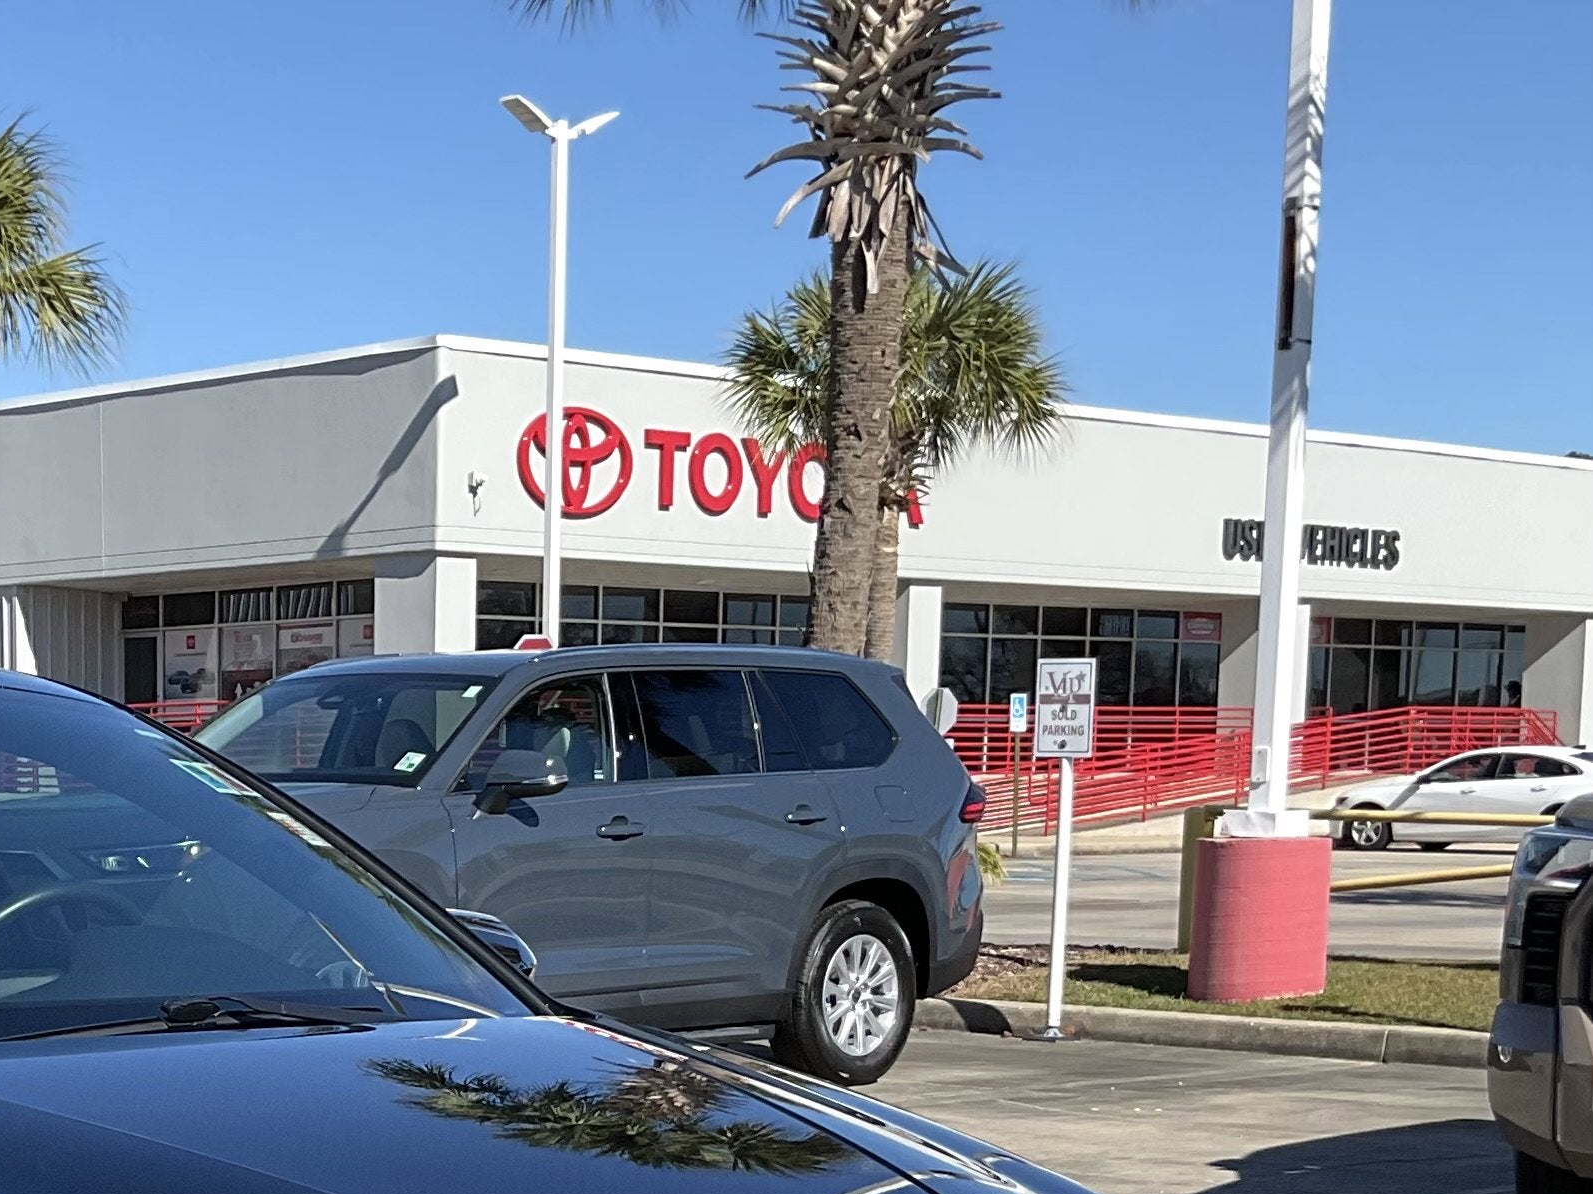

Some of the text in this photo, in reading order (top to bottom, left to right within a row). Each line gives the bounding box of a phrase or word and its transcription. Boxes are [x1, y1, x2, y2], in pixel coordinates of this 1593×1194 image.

[644, 428, 924, 528] TOYO
[1222, 517, 1265, 562] US
[1051, 709, 1077, 721] SOLD
[1042, 725, 1085, 737] PARKING
